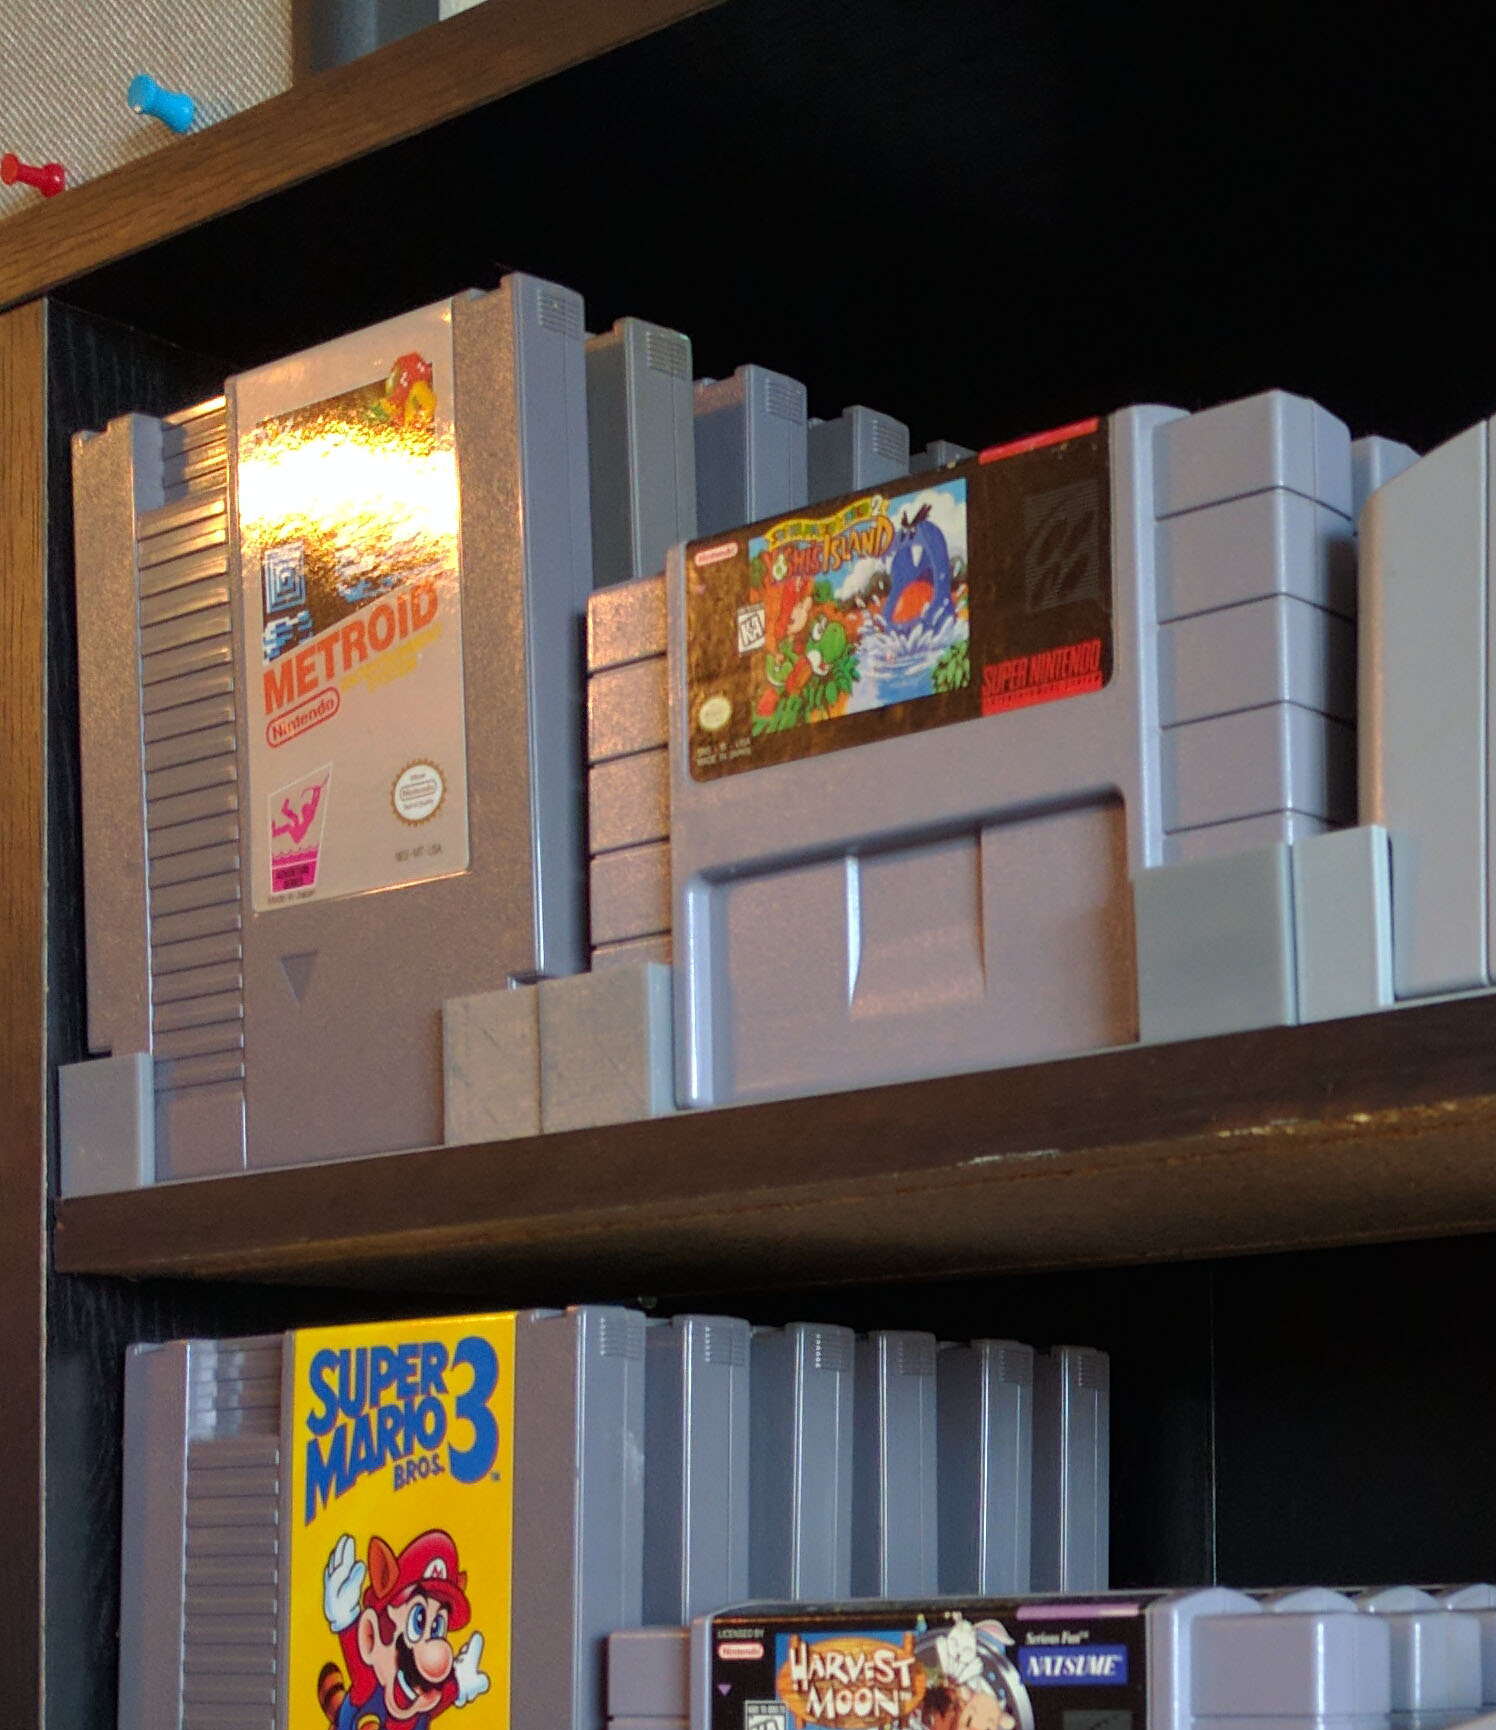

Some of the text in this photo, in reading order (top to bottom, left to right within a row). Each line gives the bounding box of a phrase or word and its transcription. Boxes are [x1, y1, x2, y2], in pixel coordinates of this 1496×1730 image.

[823, 516, 895, 574] ISLAND
[263, 581, 438, 716] METROID
[272, 698, 334, 740] Nintendo
[306, 1341, 449, 1436] SUPER
[448, 1335, 500, 1484] 3
[305, 1395, 446, 1527] MARIO
[394, 1453, 445, 1492] BROS.
[789, 1641, 915, 1692] HARVEST
[1027, 1655, 1117, 1678] NATSUME
[806, 1687, 901, 1720] MOON
